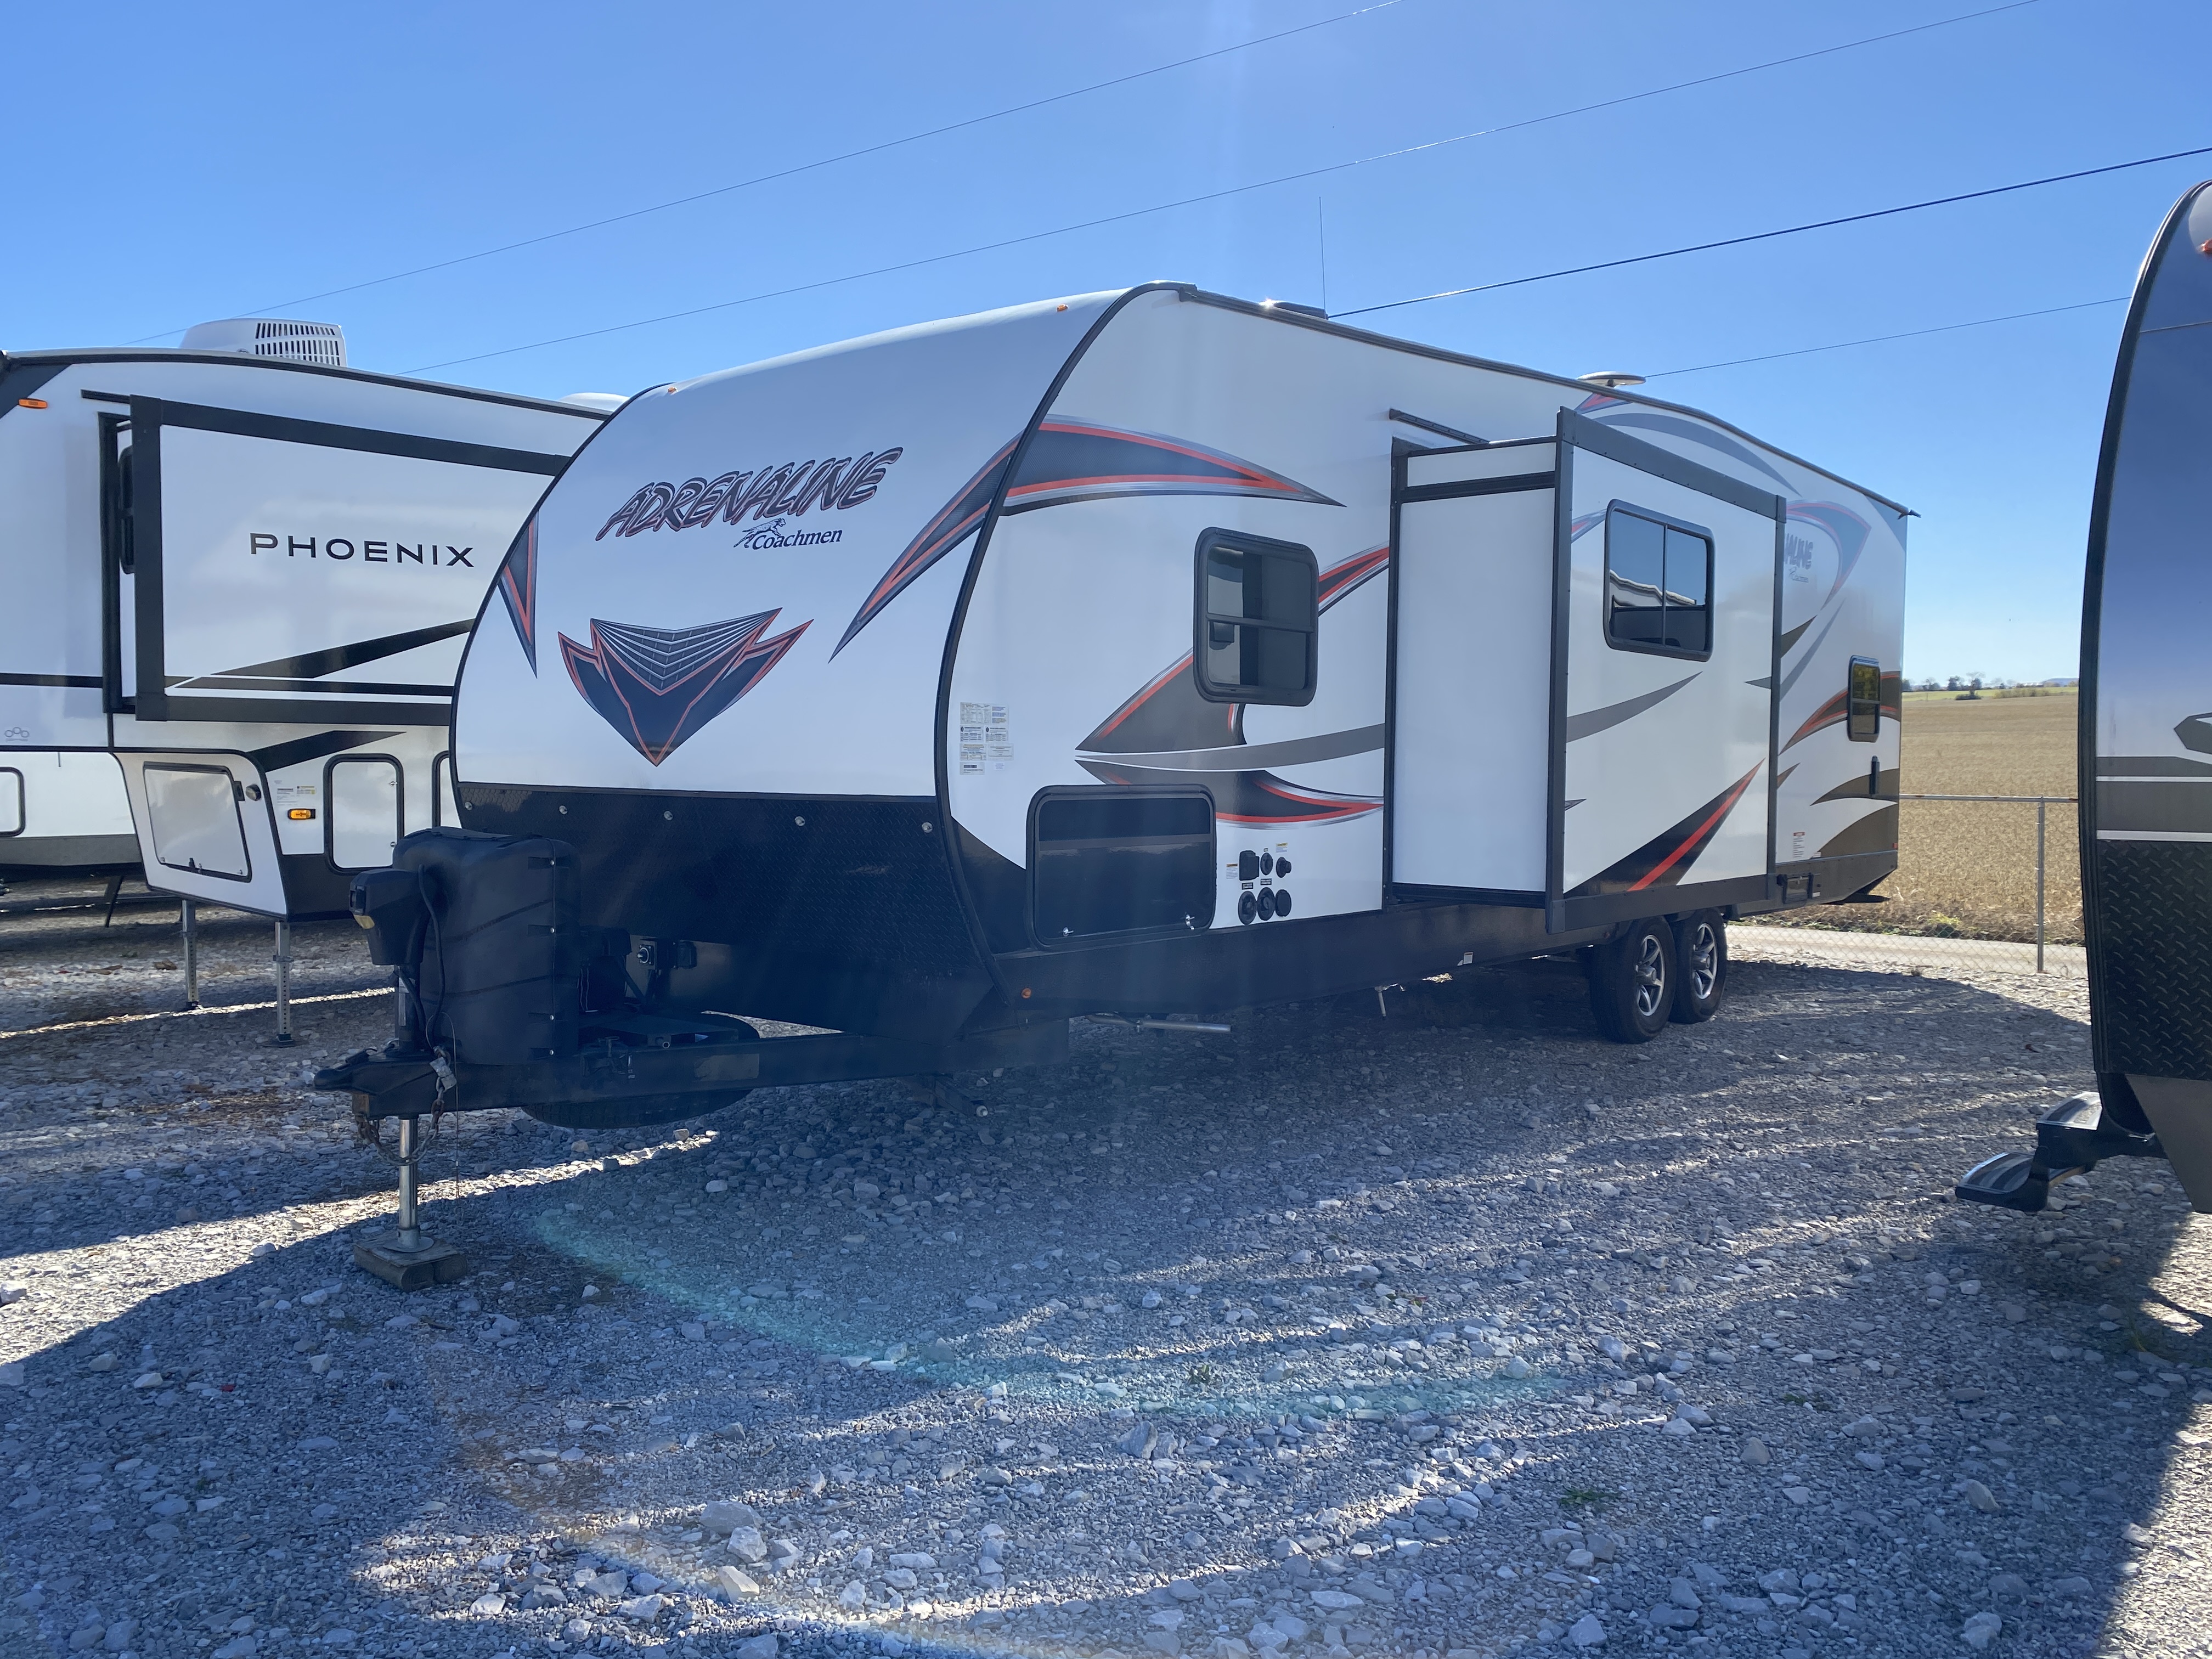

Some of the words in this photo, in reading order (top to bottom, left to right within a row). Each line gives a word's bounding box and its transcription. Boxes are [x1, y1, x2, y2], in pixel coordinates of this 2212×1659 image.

[595, 447, 904, 541] ADRENALINE
[250, 533, 475, 567] PHOENIX
[752, 529, 843, 550] Coachmen
